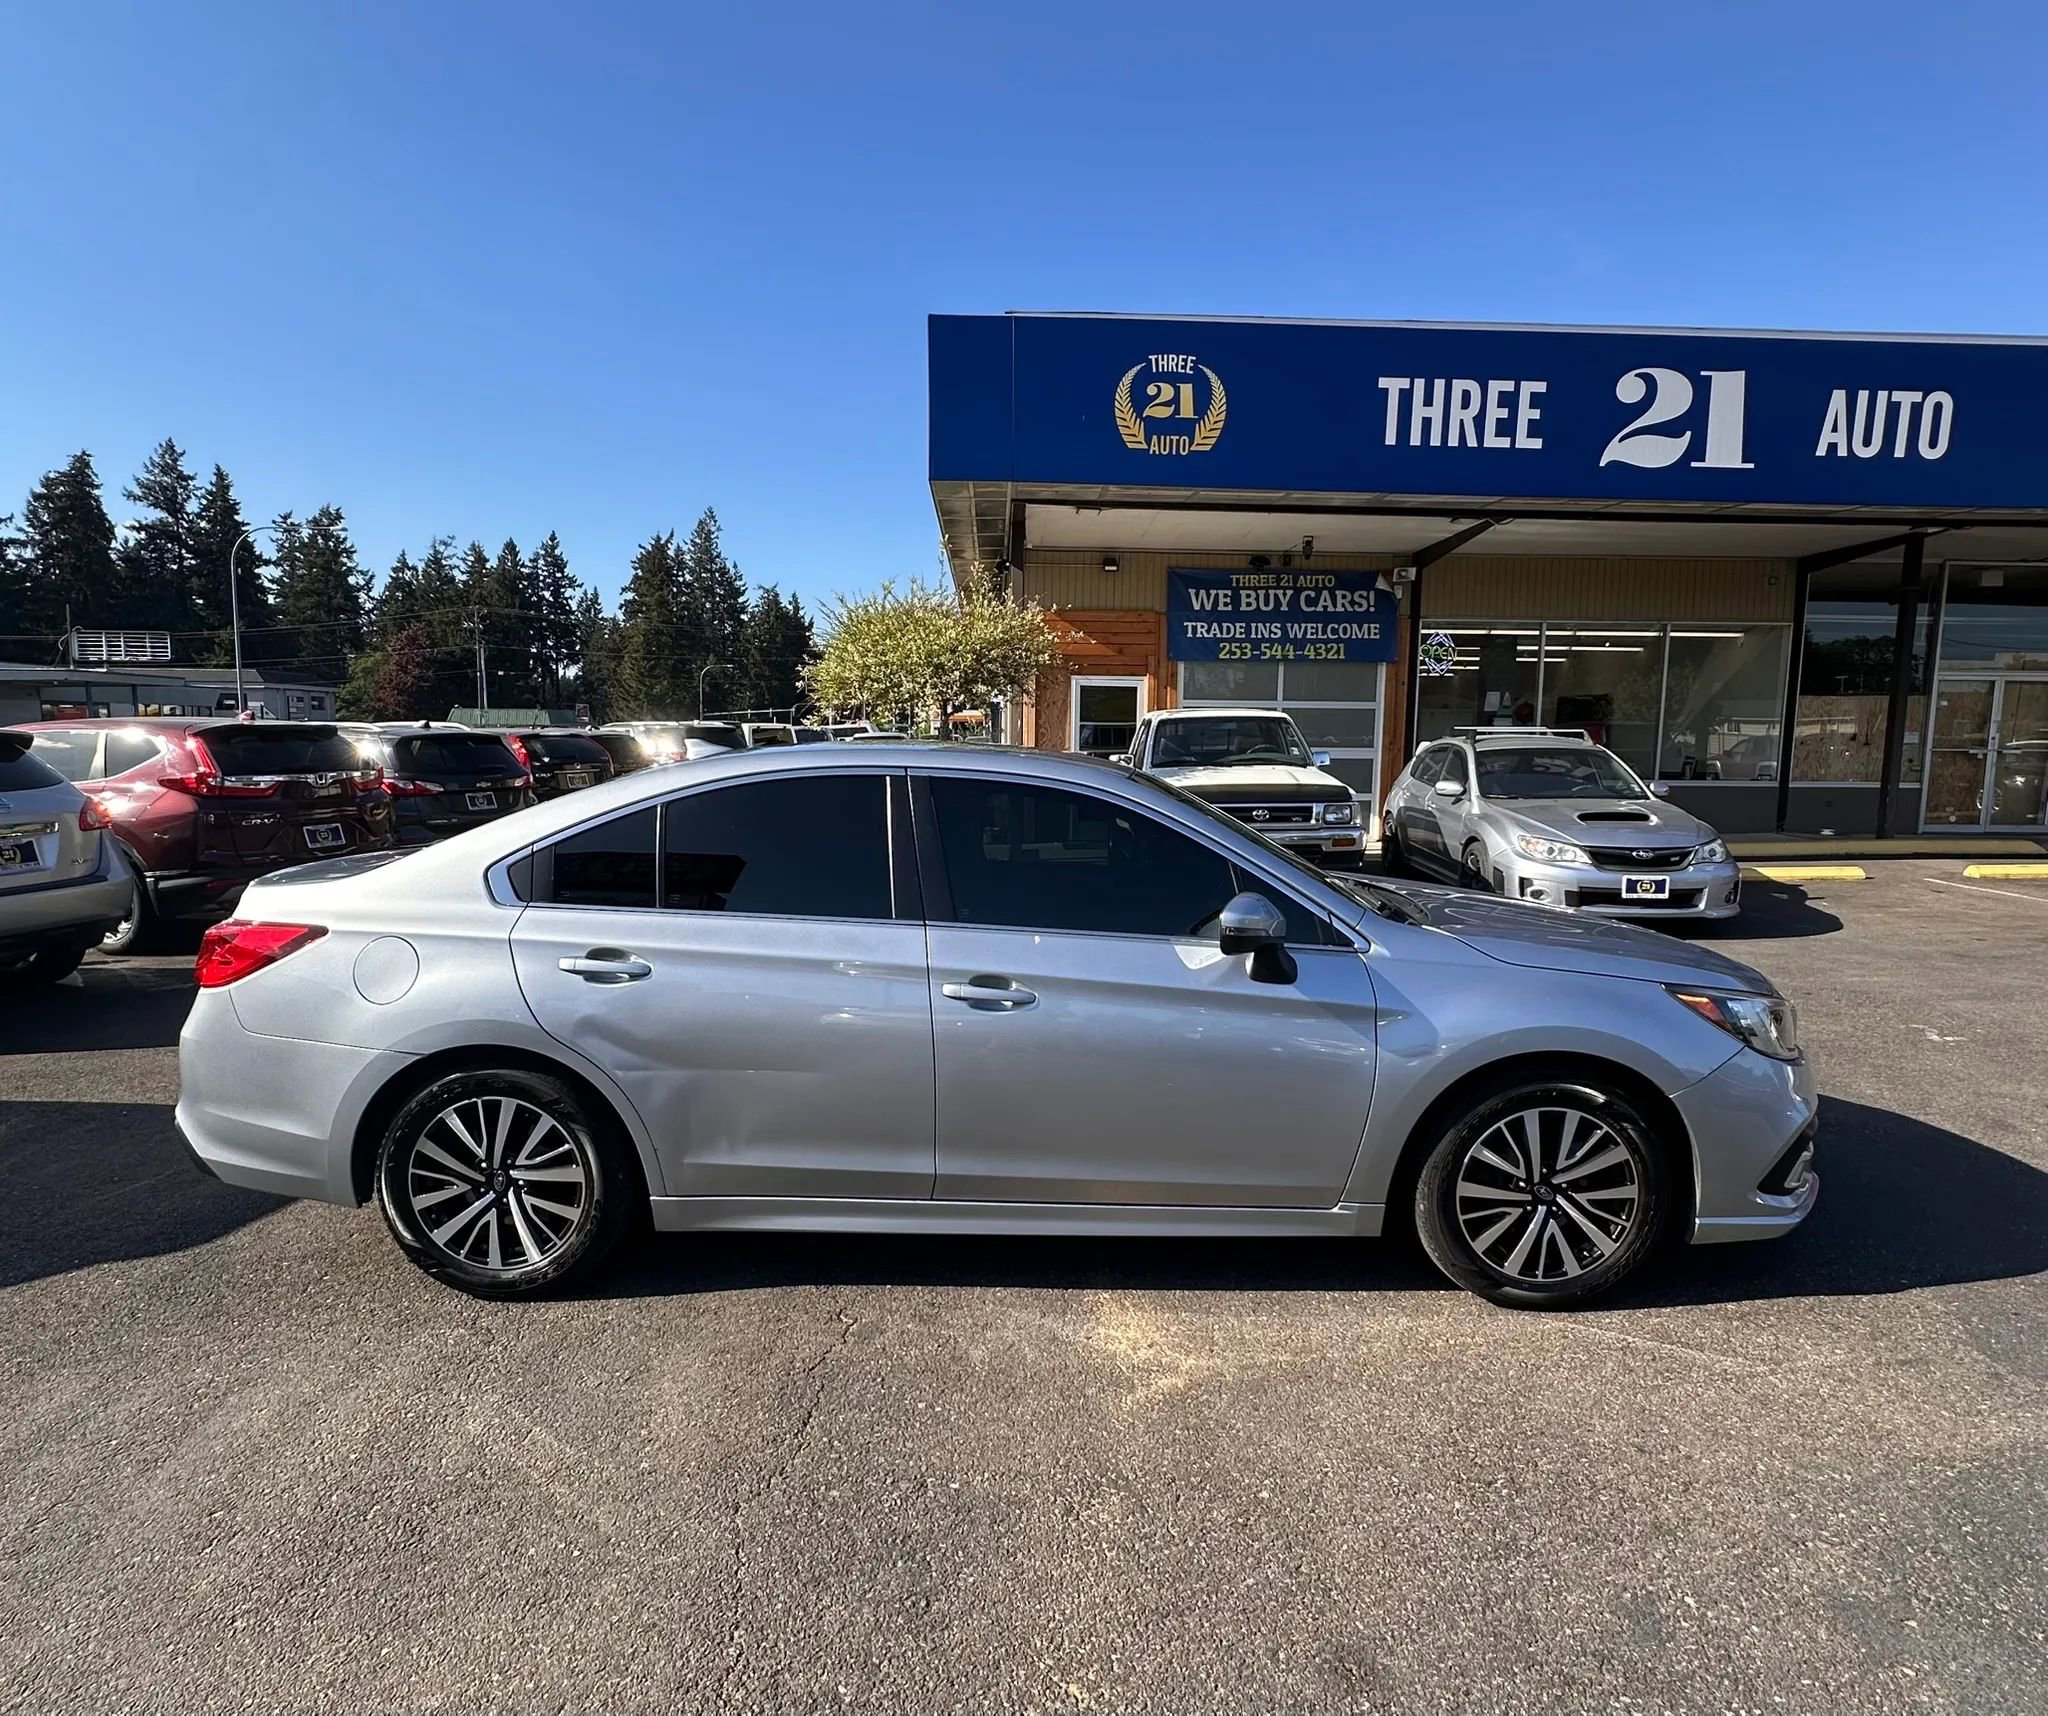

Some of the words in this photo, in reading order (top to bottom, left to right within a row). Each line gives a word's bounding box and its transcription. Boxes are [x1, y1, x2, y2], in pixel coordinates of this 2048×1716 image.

[1148, 354, 1196, 374] THREE
[1143, 382, 1199, 418] 21
[1378, 376, 1547, 449] THREE
[1600, 367, 1755, 469] 21
[1815, 389, 1954, 460] AUTO
[1149, 435, 1189, 455] AUTO
[1230, 575, 1276, 587] THREE
[1279, 575, 1294, 587] 21
[1296, 575, 1335, 587] AUTO
[1188, 588, 1232, 611] WE
[1239, 589, 1294, 611] BUY
[1300, 591, 1376, 612] CARS!
[1184, 622, 1246, 638] TRADE
[1250, 623, 1282, 639] INS
[1286, 624, 1380, 639] WELCOME
[1218, 642, 1345, 660] 253-544-4321
[1420, 644, 1457, 661] OPEN
